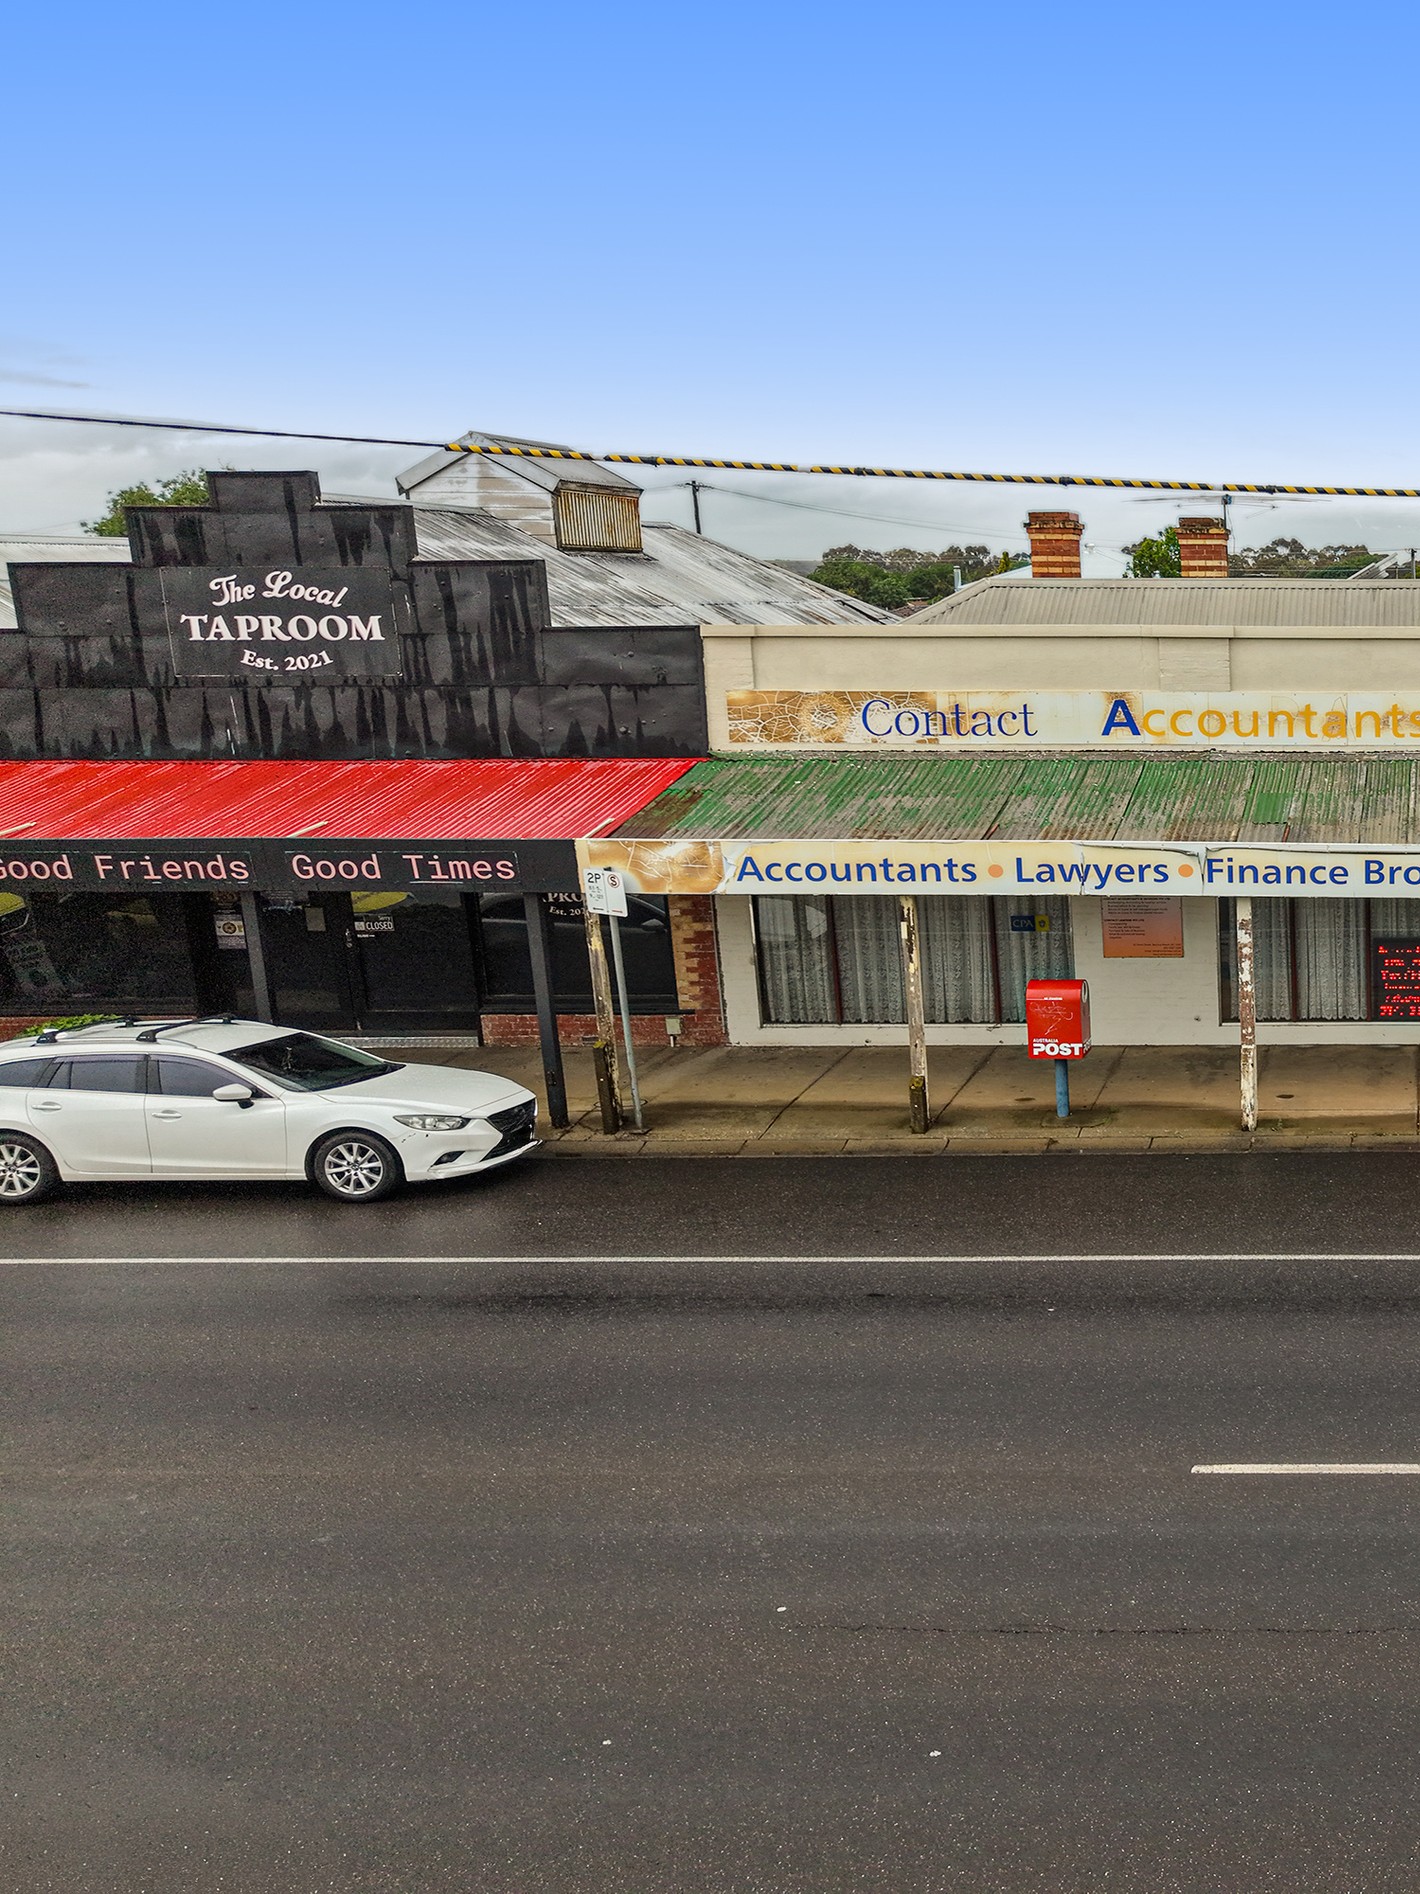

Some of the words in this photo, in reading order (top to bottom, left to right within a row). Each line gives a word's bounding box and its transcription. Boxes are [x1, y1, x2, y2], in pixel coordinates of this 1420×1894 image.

[209, 574, 256, 606] The
[262, 571, 348, 607] Local
[180, 614, 385, 641] TAPROOM
[240, 649, 279, 671] Est.
[284, 650, 334, 671] 2021
[861, 699, 1038, 737] Contact
[94, 854, 250, 880] Friends
[291, 854, 382, 880] Good
[402, 854, 516, 880] Times
[587, 872, 602, 884] 2P
[737, 856, 977, 883] Accountants
[1015, 857, 1170, 890] Lawyers
[1206, 857, 1349, 885] Finance
[365, 921, 393, 930] CLOSED
[1012, 919, 1034, 928] CPA
[1033, 1043, 1083, 1056] POST
